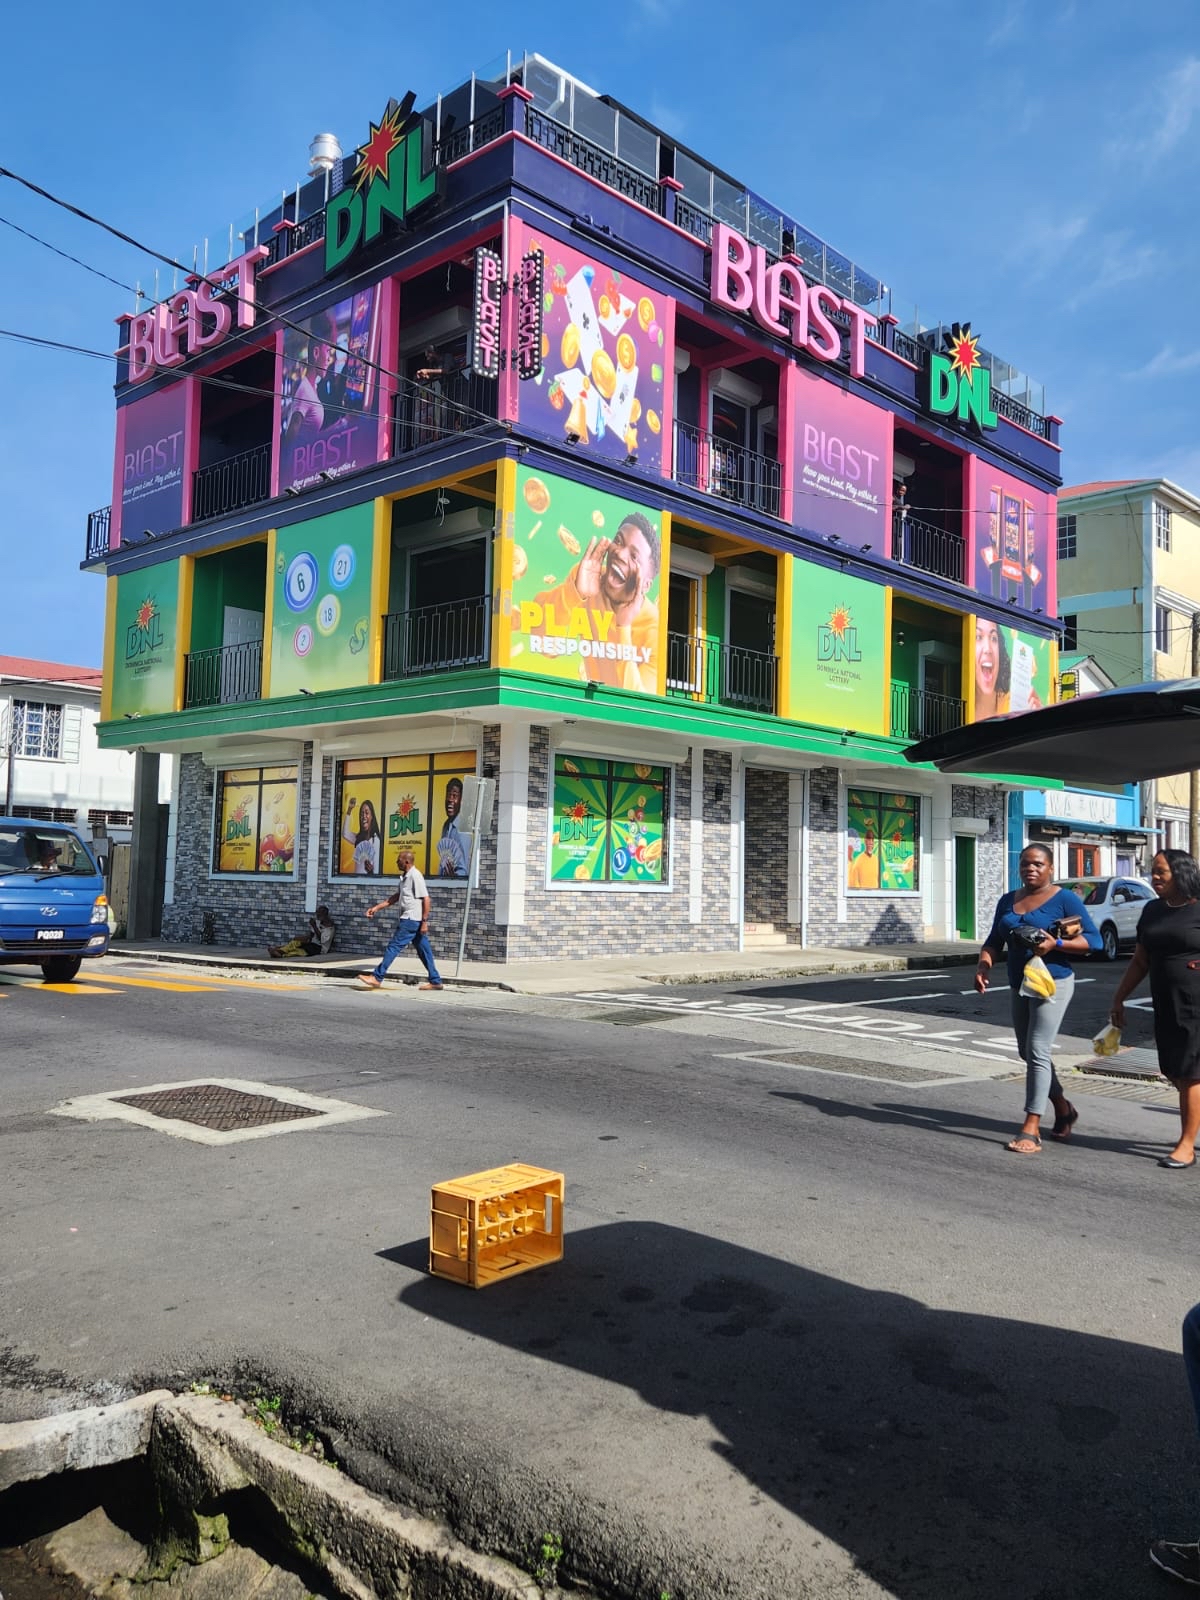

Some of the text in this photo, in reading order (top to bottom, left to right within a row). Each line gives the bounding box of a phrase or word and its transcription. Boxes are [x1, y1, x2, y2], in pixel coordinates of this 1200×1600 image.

[324, 122, 437, 273] DNL
[128, 244, 269, 384] BLAST
[480, 256, 497, 368] BLAST
[519, 259, 537, 368] BLAST
[711, 222, 877, 378] BLAST
[929, 351, 999, 430] DNL
[123, 430, 183, 485] BLAST
[293, 426, 359, 479] BLAST
[803, 423, 879, 489] BLAST
[297, 572, 306, 592] 6
[336, 560, 348, 576] 21
[324, 607, 333, 622] 18
[520, 601, 614, 641] PLAY
[126, 613, 164, 660] DNL
[530, 635, 652, 664] RESPONSIBLY
[817, 625, 862, 663] DNL
[226, 815, 251, 841] DNL
[389, 808, 423, 838] DNL
[559, 815, 598, 842] DNL
[615, 852, 622, 866] 1
